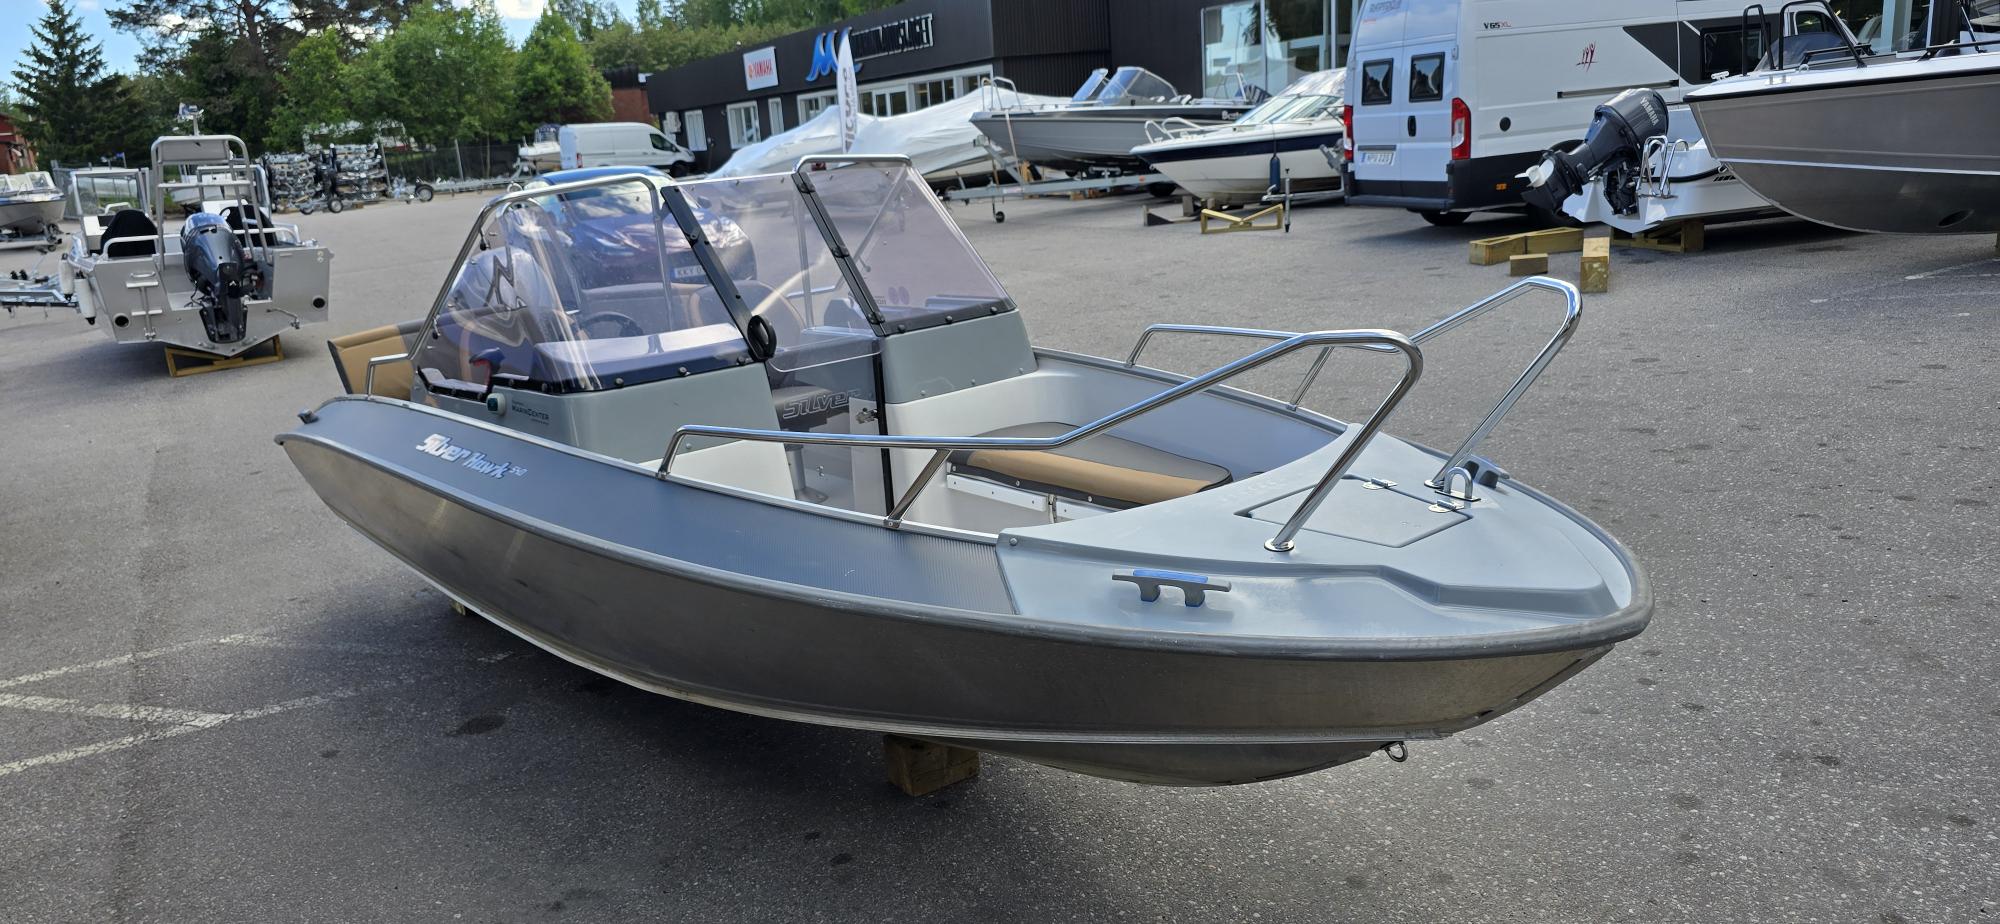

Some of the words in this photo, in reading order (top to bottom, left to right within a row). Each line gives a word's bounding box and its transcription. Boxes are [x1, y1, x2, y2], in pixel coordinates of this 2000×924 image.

[1640, 96, 1659, 126] YAMAHA
[416, 433, 472, 462] Silver
[462, 452, 512, 479] Hawk
